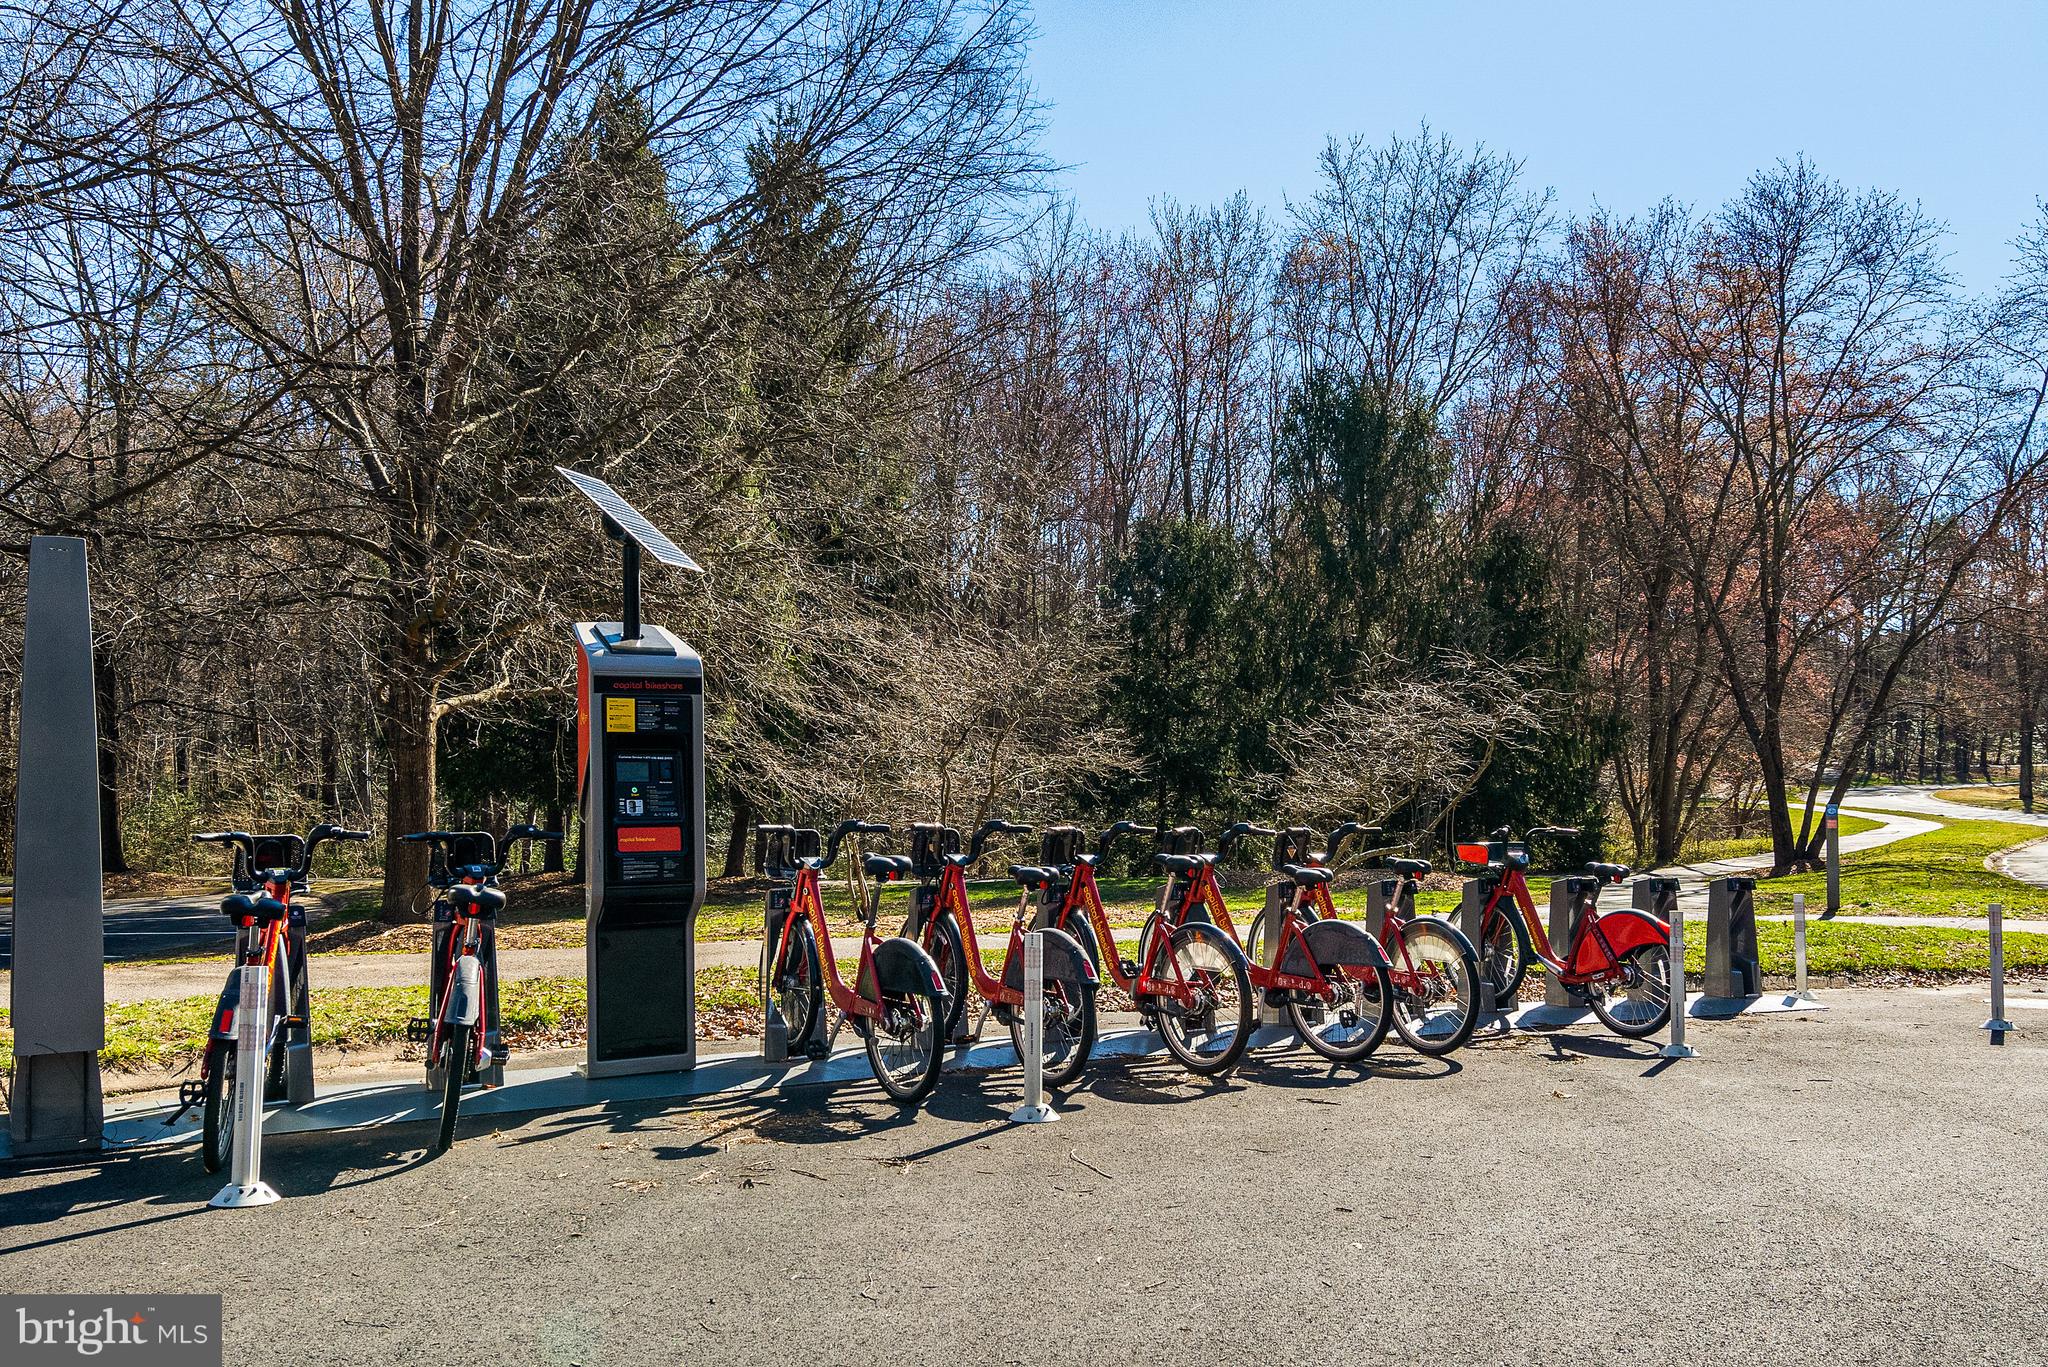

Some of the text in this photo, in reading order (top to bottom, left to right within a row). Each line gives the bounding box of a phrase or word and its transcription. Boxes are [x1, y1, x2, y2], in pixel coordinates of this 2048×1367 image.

[613, 680, 684, 690] capital bikeshare
[1084, 885, 1114, 970] capital bikeshare
[1204, 884, 1224, 918] capital
[1316, 890, 1331, 917] apital
[807, 895, 832, 989] capital bikeshare
[952, 889, 977, 978] capital bikeshare
